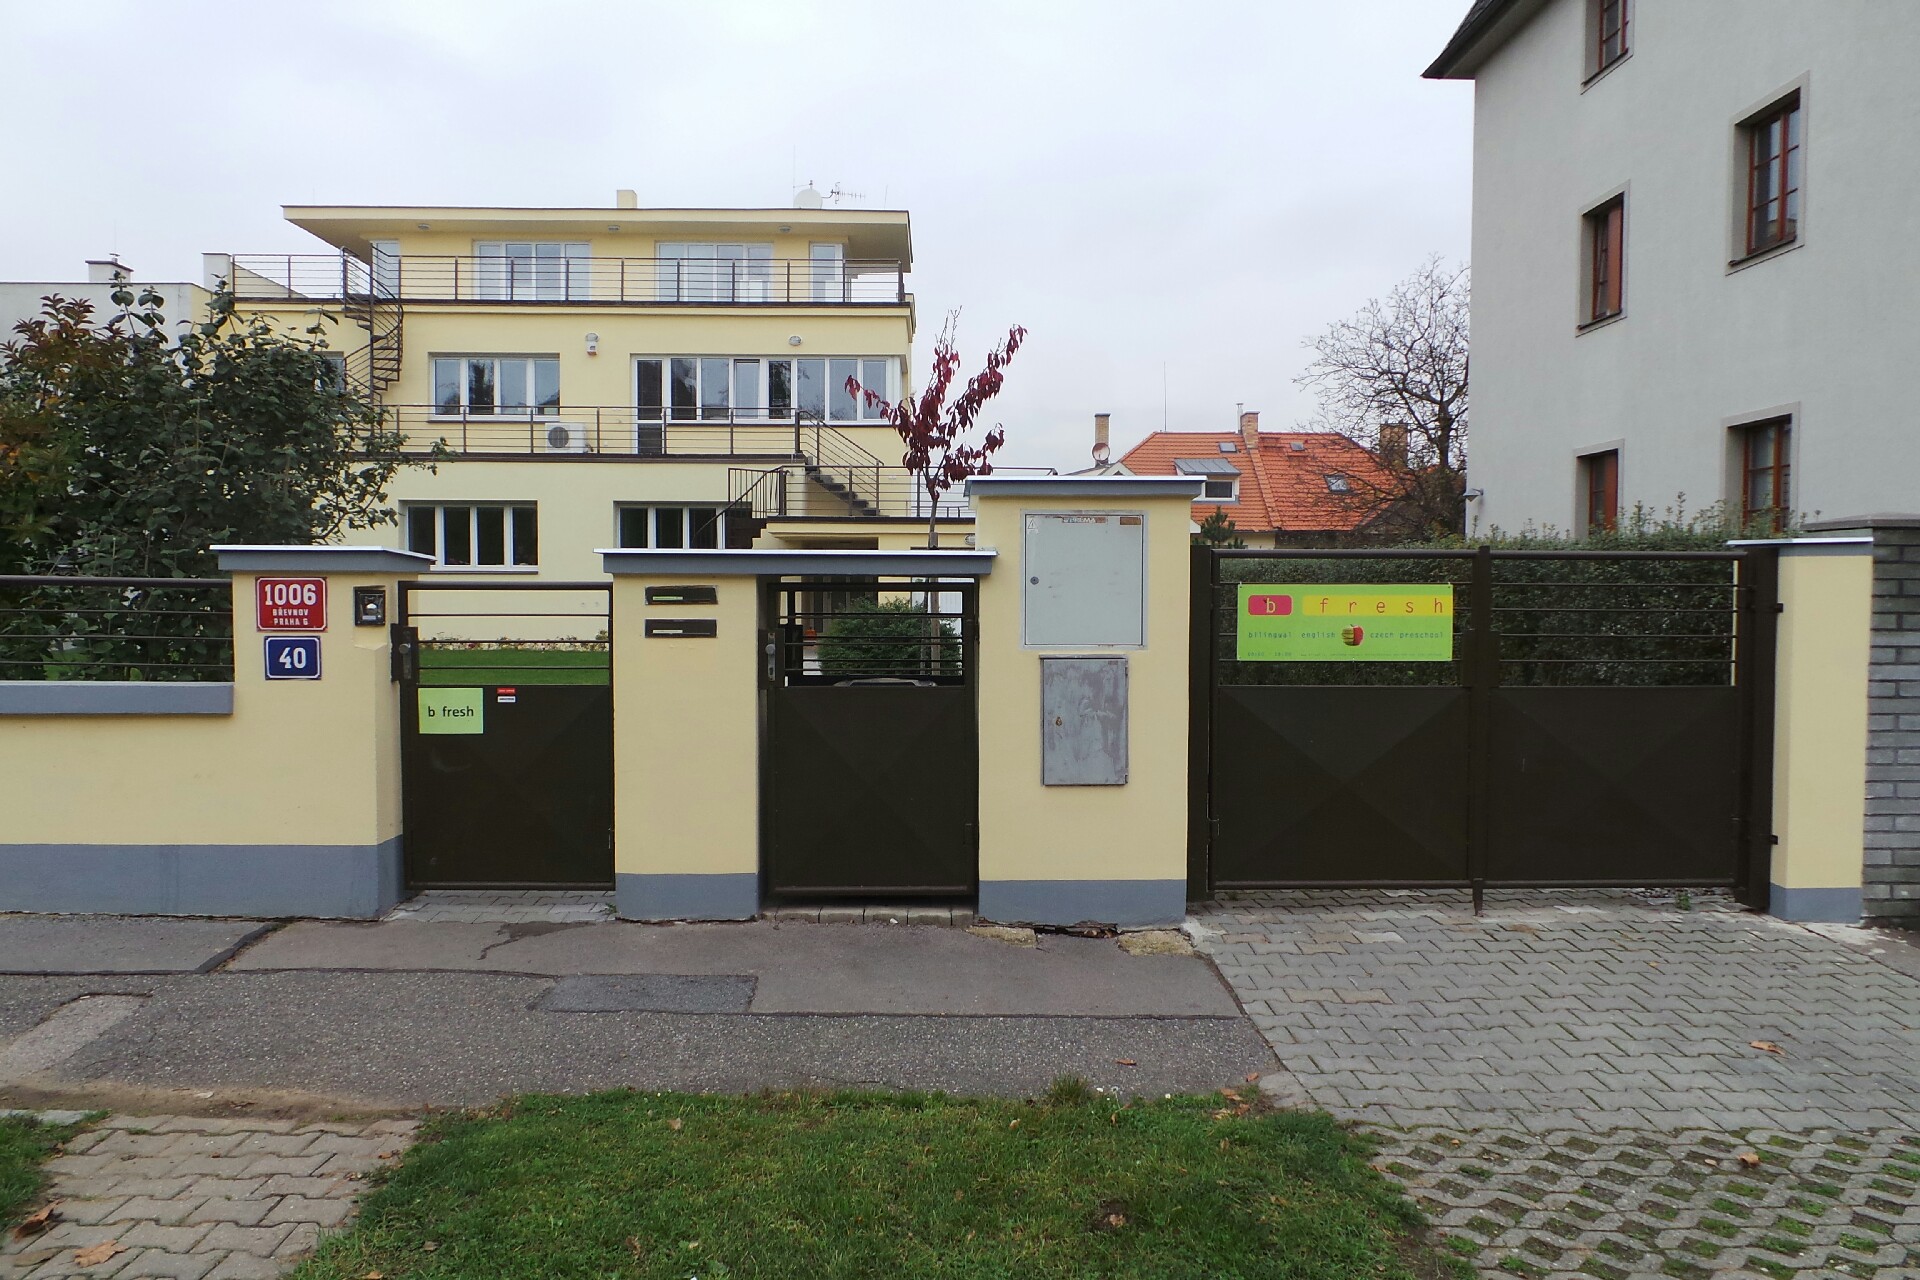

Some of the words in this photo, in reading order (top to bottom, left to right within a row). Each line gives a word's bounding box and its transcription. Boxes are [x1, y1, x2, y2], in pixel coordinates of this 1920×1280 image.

[264, 583, 317, 606] 1006
[272, 606, 309, 616] BŘEVNOV
[1265, 597, 1276, 614] b
[1319, 597, 1443, 614] fresh
[273, 617, 301, 626] PRAHA
[302, 617, 309, 626] 6
[1247, 631, 1292, 640] bilingual
[1301, 631, 1336, 640] english
[1369, 631, 1394, 639] czech
[1399, 631, 1444, 640] preschool
[278, 647, 307, 669] 40
[427, 705, 436, 717] b
[442, 705, 474, 717] fresh
